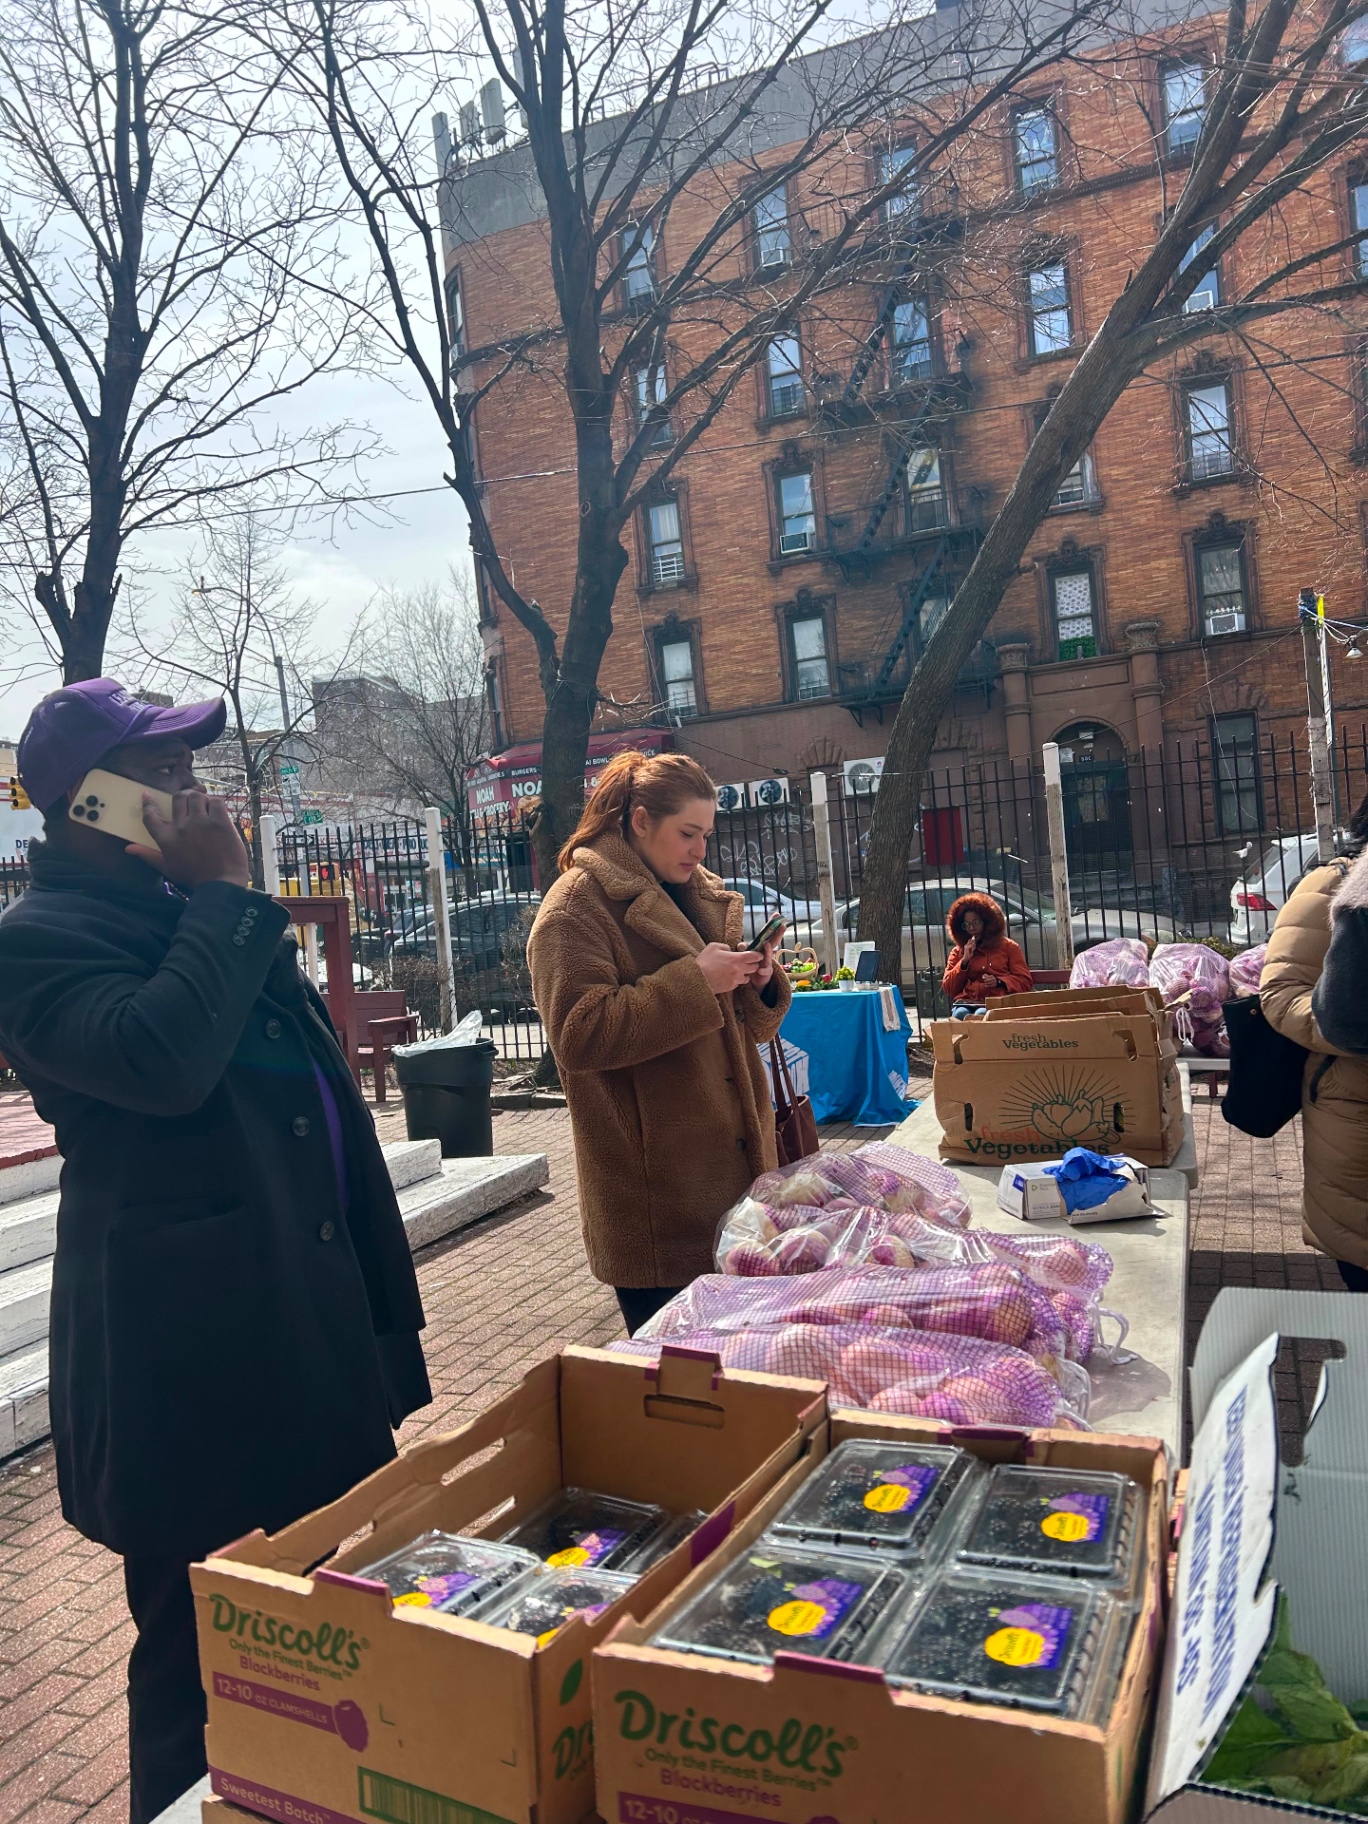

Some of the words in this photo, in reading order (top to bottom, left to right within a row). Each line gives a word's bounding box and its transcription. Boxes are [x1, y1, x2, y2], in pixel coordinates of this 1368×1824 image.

[511, 766, 537, 776] BURGERS
[475, 785, 495, 805] NOAH
[511, 779, 542, 798] NOA
[15, 839, 29, 849] DE
[1002, 1039, 1079, 1051] Vegetables
[1011, 1033, 1047, 1043] fresh
[980, 1126, 1042, 1142] fresh
[229, 1638, 251, 1656] Only
[254, 1645, 271, 1660] the
[272, 1651, 304, 1670] Finest
[240, 1655, 320, 1691] Blackberries
[217, 1678, 253, 1701] 12-10
[269, 1698, 328, 1724] CLAMSHELLS
[645, 1748, 679, 1768] Only
[682, 1755, 707, 1771] the
[711, 1759, 758, 1780] Finest
[661, 1768, 781, 1807] Blackberries
[220, 1777, 282, 1812] Sweetest
[284, 1802, 324, 1824] Batch
[624, 1800, 680, 1824] 12-10
